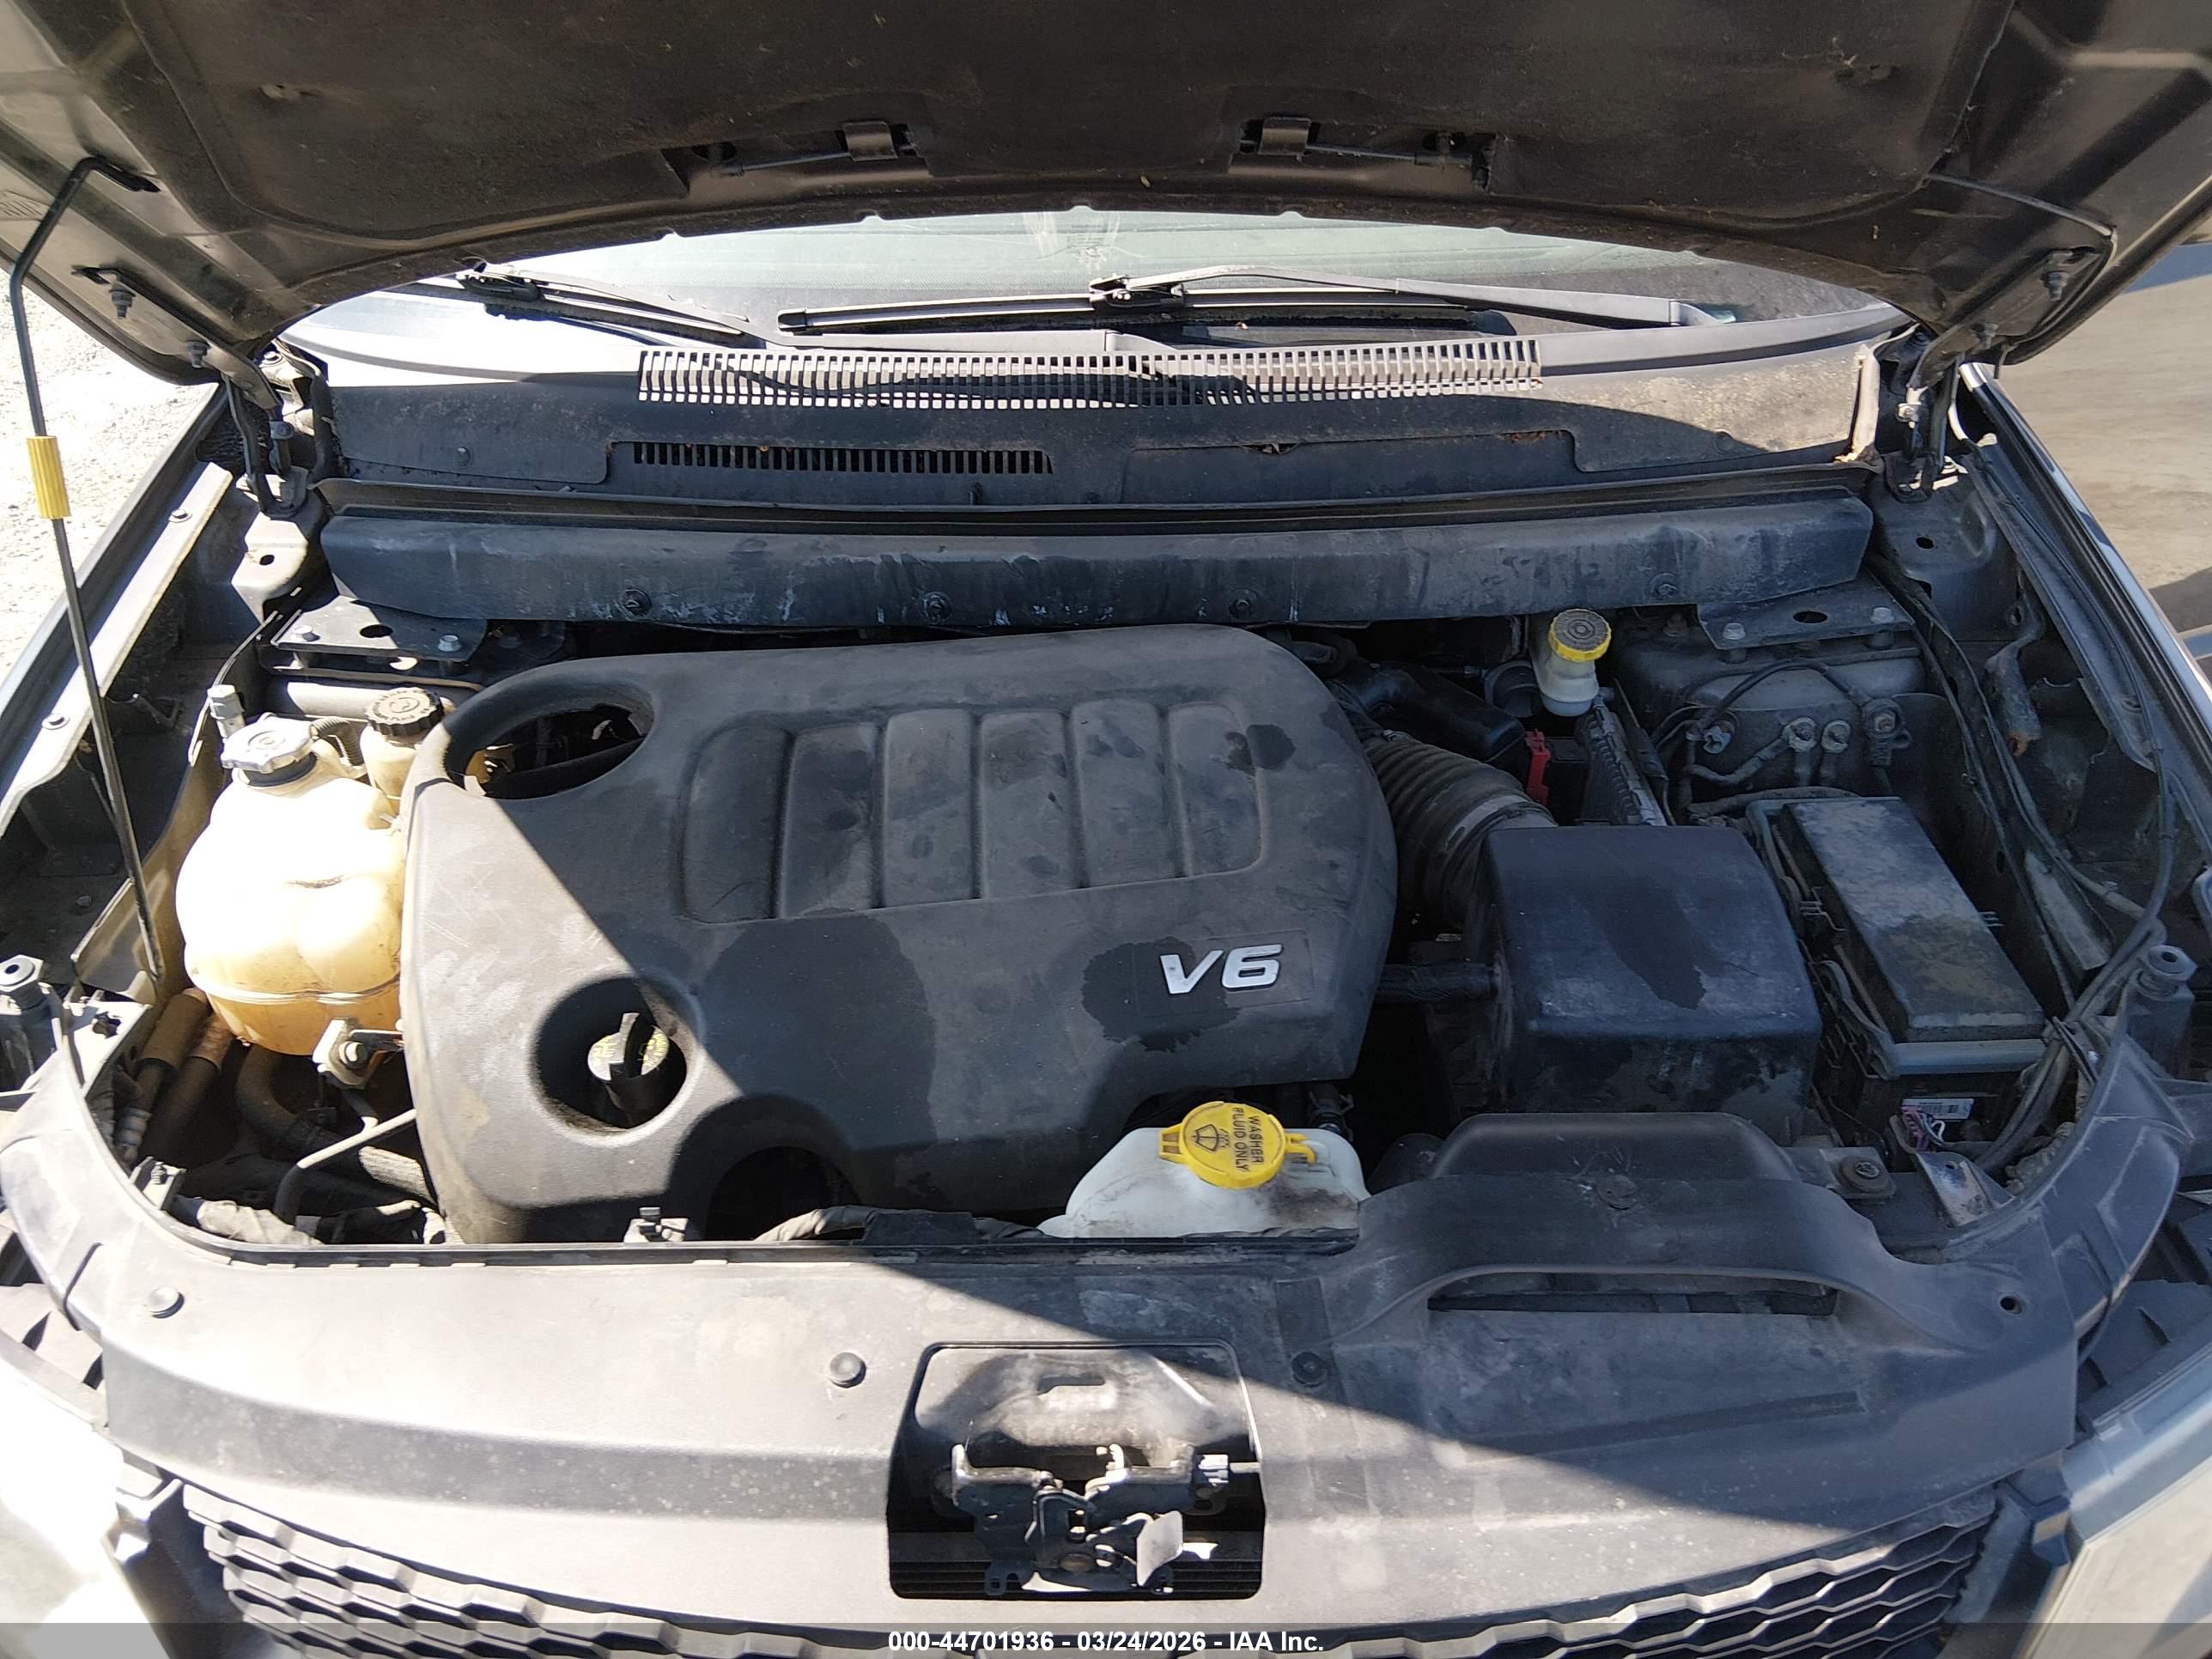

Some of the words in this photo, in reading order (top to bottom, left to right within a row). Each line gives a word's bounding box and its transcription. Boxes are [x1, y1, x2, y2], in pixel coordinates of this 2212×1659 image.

[1159, 944, 1283, 994] V6
[1231, 1107, 1247, 1139] FLUID
[1248, 1115, 1264, 1164] WASHER
[1234, 1141, 1250, 1172] ONLY
